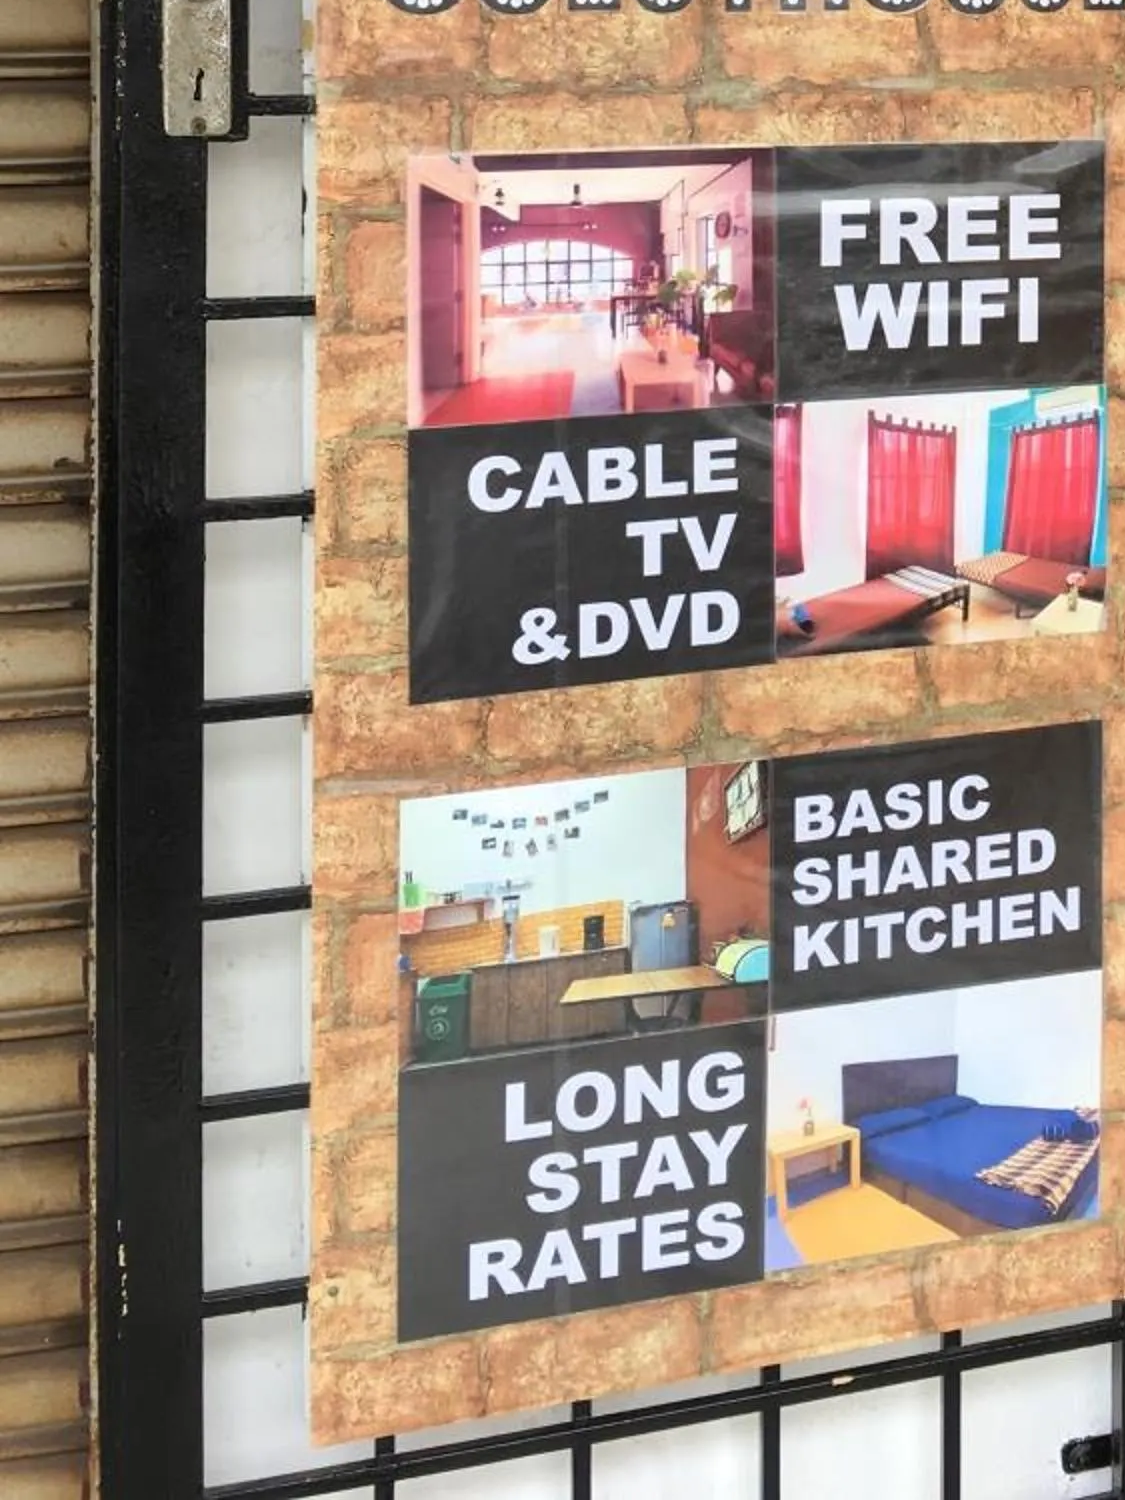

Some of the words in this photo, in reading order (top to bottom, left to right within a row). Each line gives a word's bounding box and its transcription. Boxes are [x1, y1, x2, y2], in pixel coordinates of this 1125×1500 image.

[819, 192, 1061, 267] FREE
[834, 277, 1039, 351] WIFI
[467, 437, 739, 513] CABLE
[626, 513, 737, 576] TV
[512, 589, 740, 665] &DVD
[793, 774, 991, 843] BASIC
[792, 828, 1057, 906] SHARED
[793, 886, 1082, 972] KITCHEN
[504, 1050, 747, 1143] LONG
[526, 1123, 748, 1214] STAY
[468, 1201, 746, 1301] RATES
